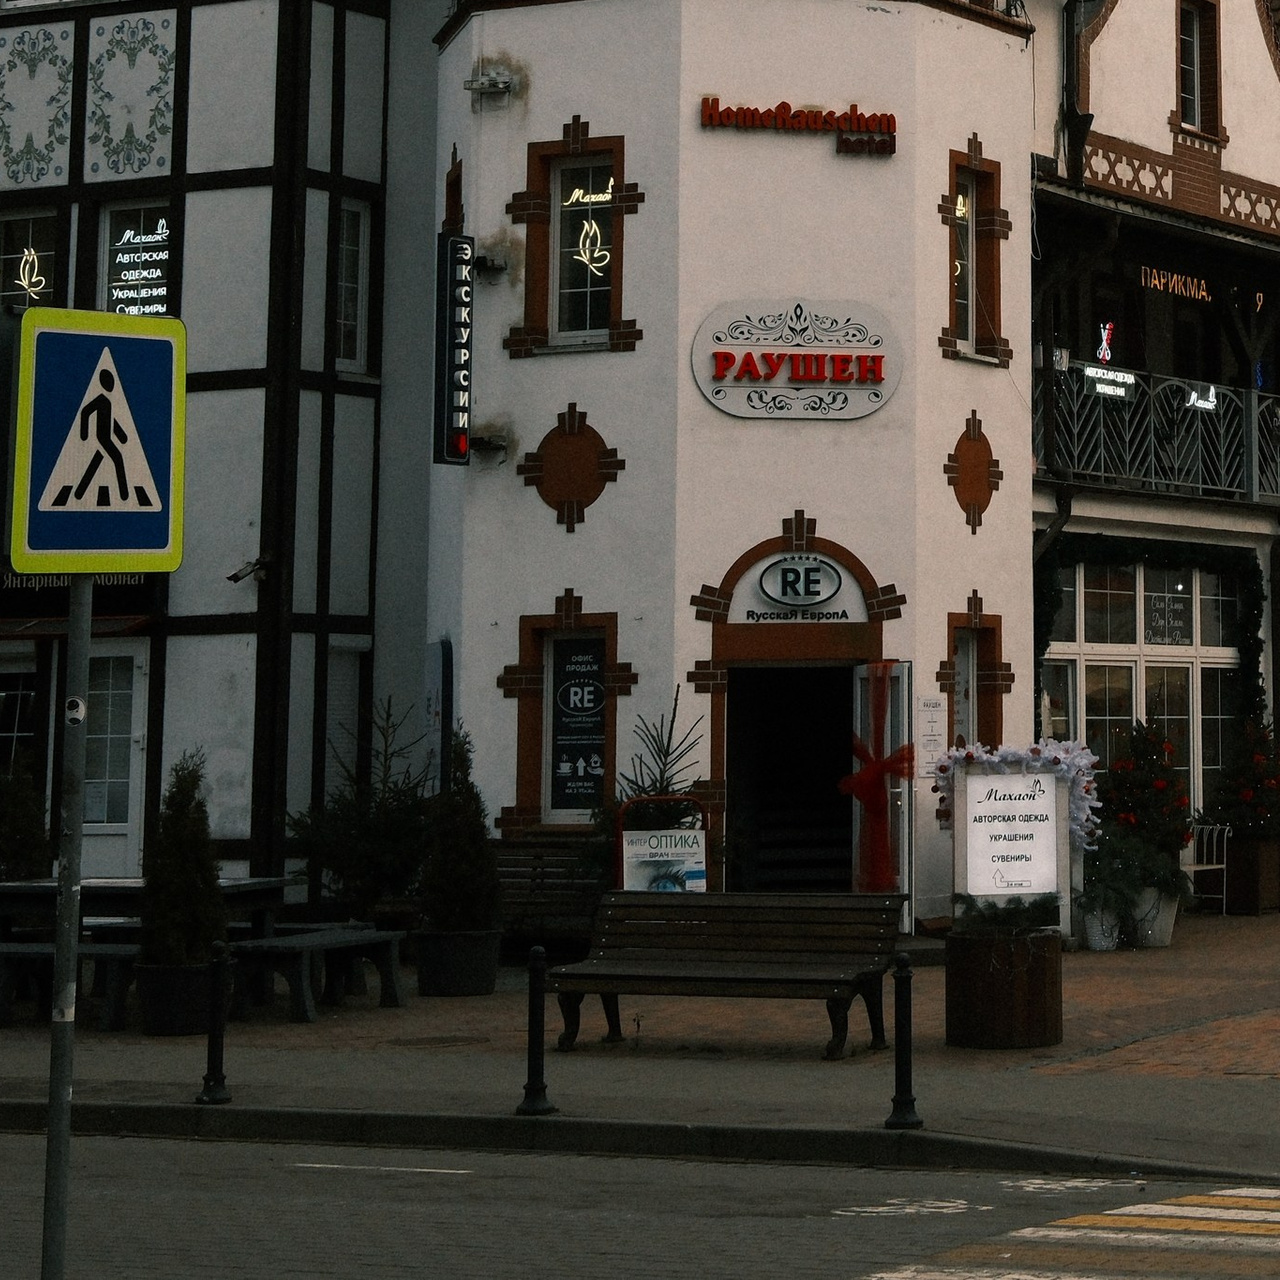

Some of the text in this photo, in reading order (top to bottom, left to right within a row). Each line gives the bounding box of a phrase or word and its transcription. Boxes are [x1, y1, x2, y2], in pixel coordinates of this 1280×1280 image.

[701, 97, 897, 133] HomeRauschen
[837, 131, 897, 154] hotel
[115, 229, 164, 245] Махаон
[121, 268, 163, 281] ОДЕЖДА
[454, 244, 472, 429] ЭКСКУРСИИ
[712, 351, 885, 383] РАУШЕН
[3, 573, 72, 591] Янтарный
[781, 567, 821, 596] RE
[565, 664, 599, 672] ПРОДАЖ
[570, 686, 595, 708] RE
[977, 788, 1036, 804] Махаон
[973, 814, 1050, 824] АВТОРСКАЯ ОДЕЖДА
[989, 833, 1034, 842] УКРАШЕНИЯ
[991, 854, 1032, 863] СУВЕНИРЫ
